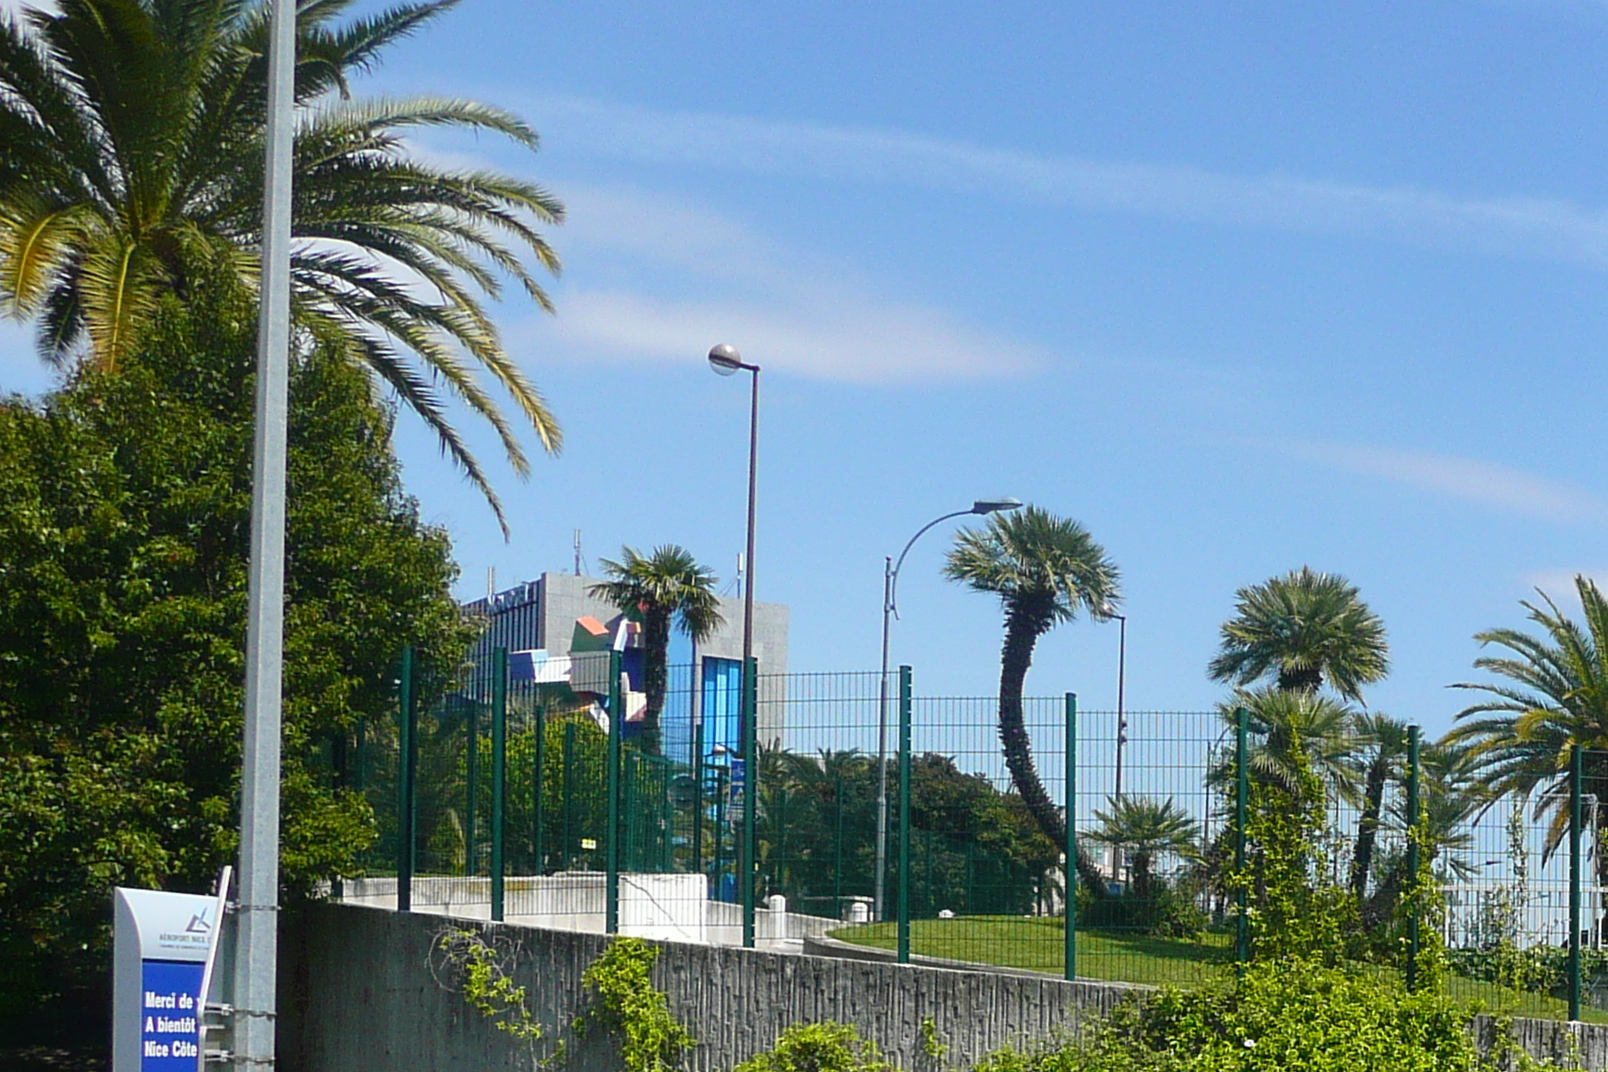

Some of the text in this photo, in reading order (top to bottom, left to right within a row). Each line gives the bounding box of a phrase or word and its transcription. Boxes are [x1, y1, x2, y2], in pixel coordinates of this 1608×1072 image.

[145, 991, 177, 1009] Merci
[179, 992, 193, 1010] de
[145, 1015, 196, 1033] A bientôt
[144, 1040, 198, 1058] Nice Côte
